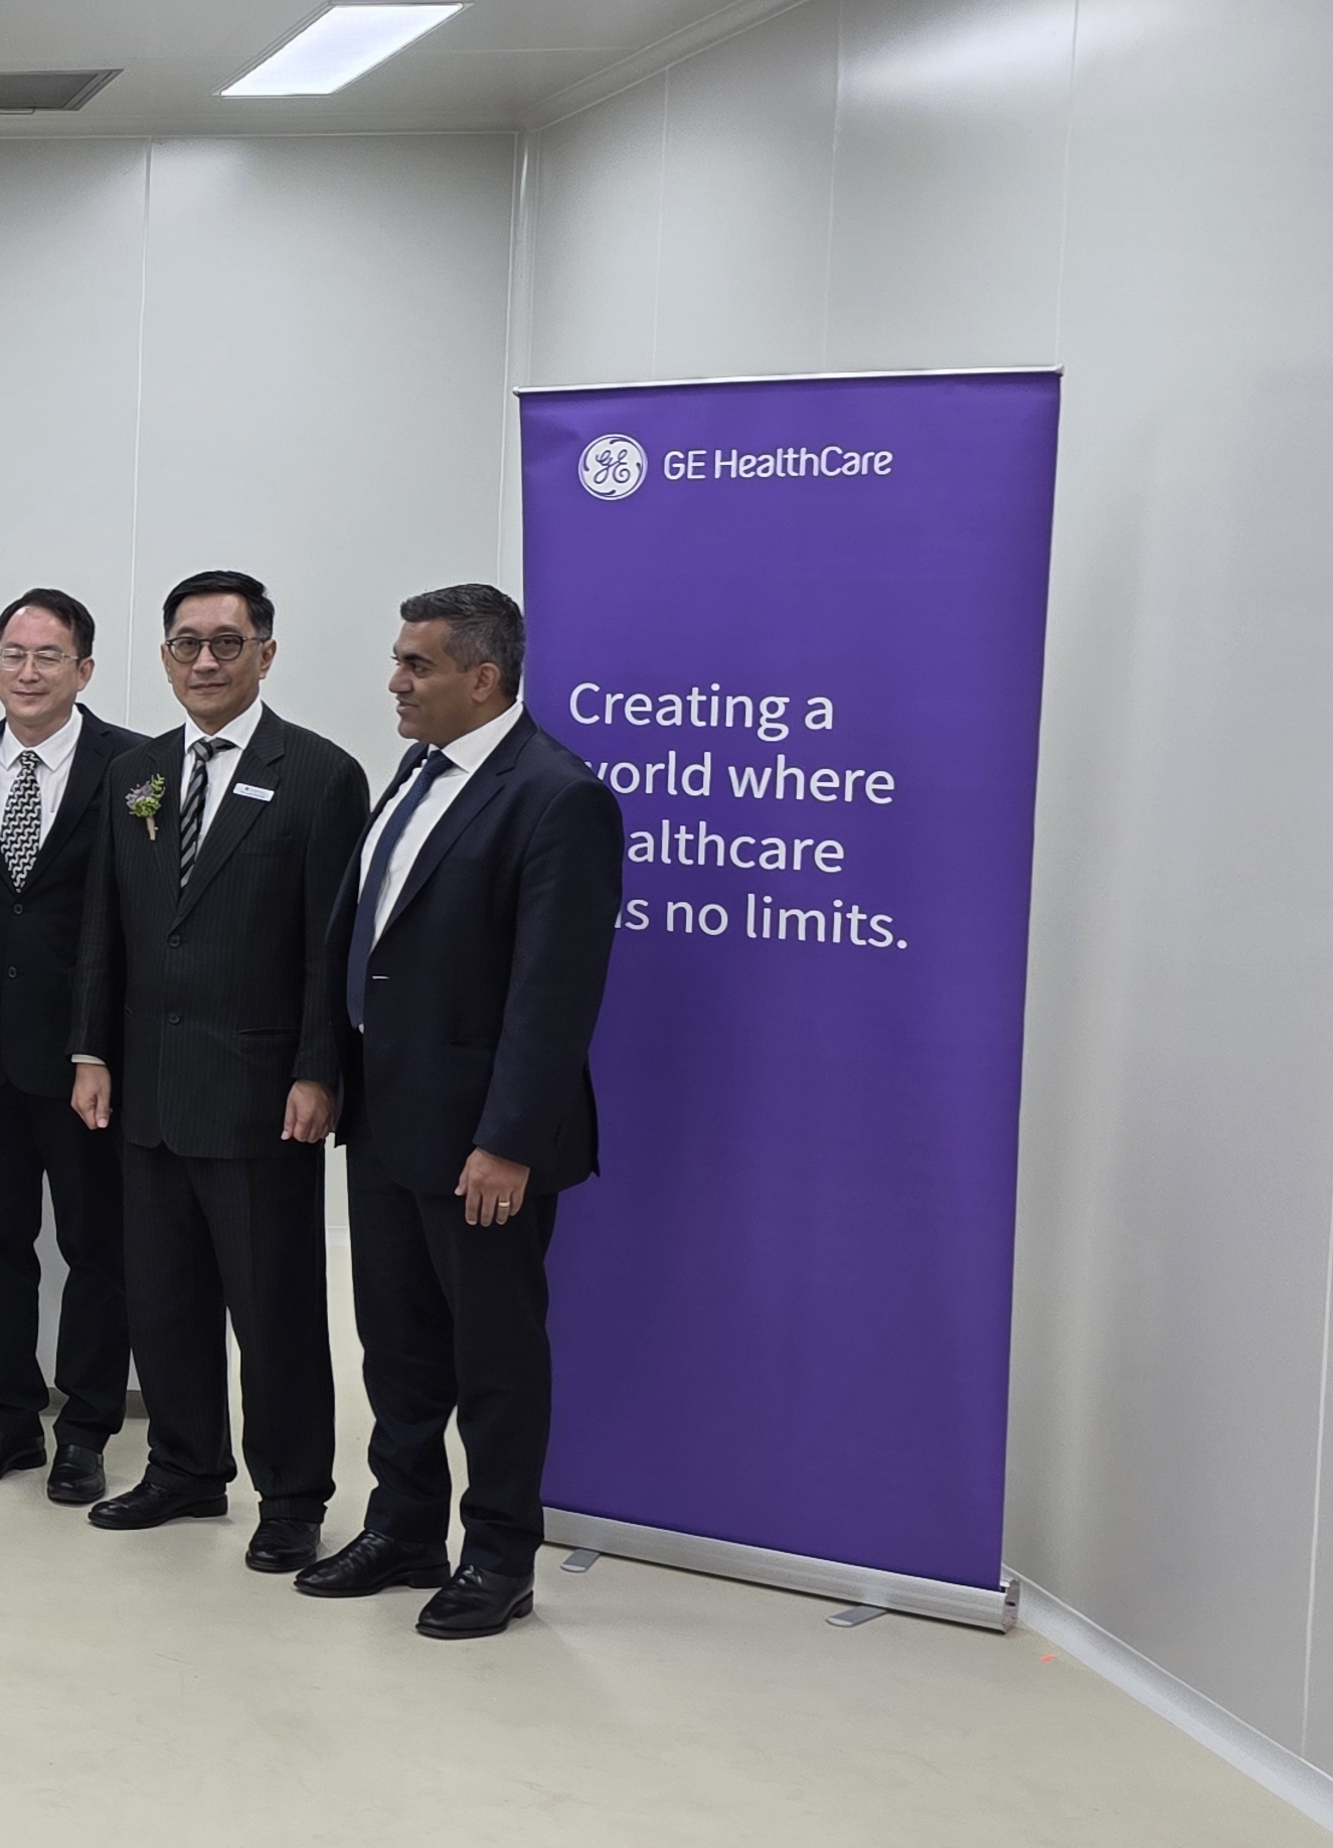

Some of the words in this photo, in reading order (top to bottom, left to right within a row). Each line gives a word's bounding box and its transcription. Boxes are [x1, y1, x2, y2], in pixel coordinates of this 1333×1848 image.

[663, 449, 707, 480] GE
[714, 446, 893, 479] HealthCare
[569, 682, 790, 742] Creating
[804, 696, 833, 730] a
[727, 753, 895, 805] where
[627, 819, 845, 873] althcare
[666, 901, 729, 936] no
[746, 893, 908, 949] limits.
